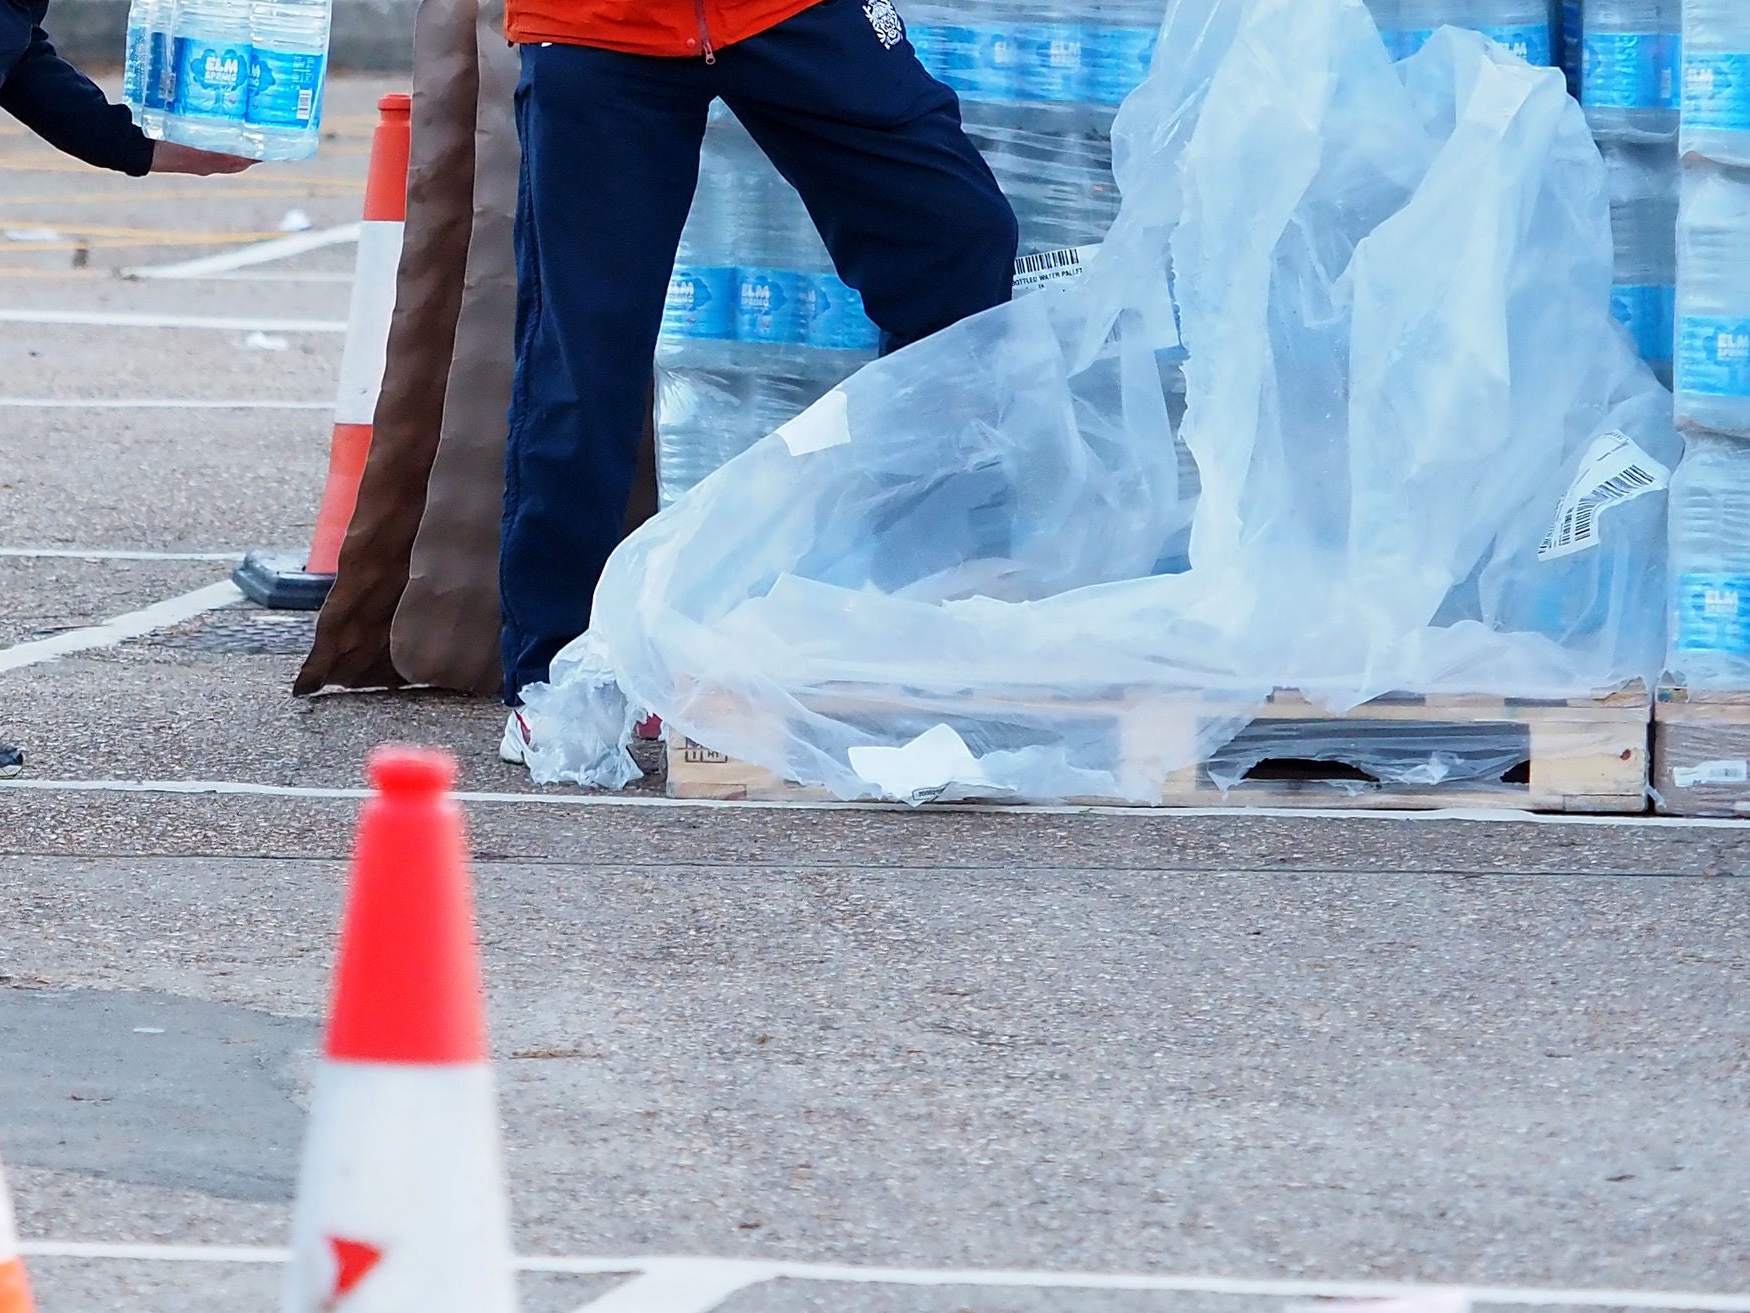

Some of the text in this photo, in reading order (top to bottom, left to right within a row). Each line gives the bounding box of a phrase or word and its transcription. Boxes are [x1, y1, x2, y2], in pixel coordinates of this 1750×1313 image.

[205, 56, 239, 75] ELM
[1039, 272, 1061, 281] WATER
[741, 283, 770, 298] ELM
